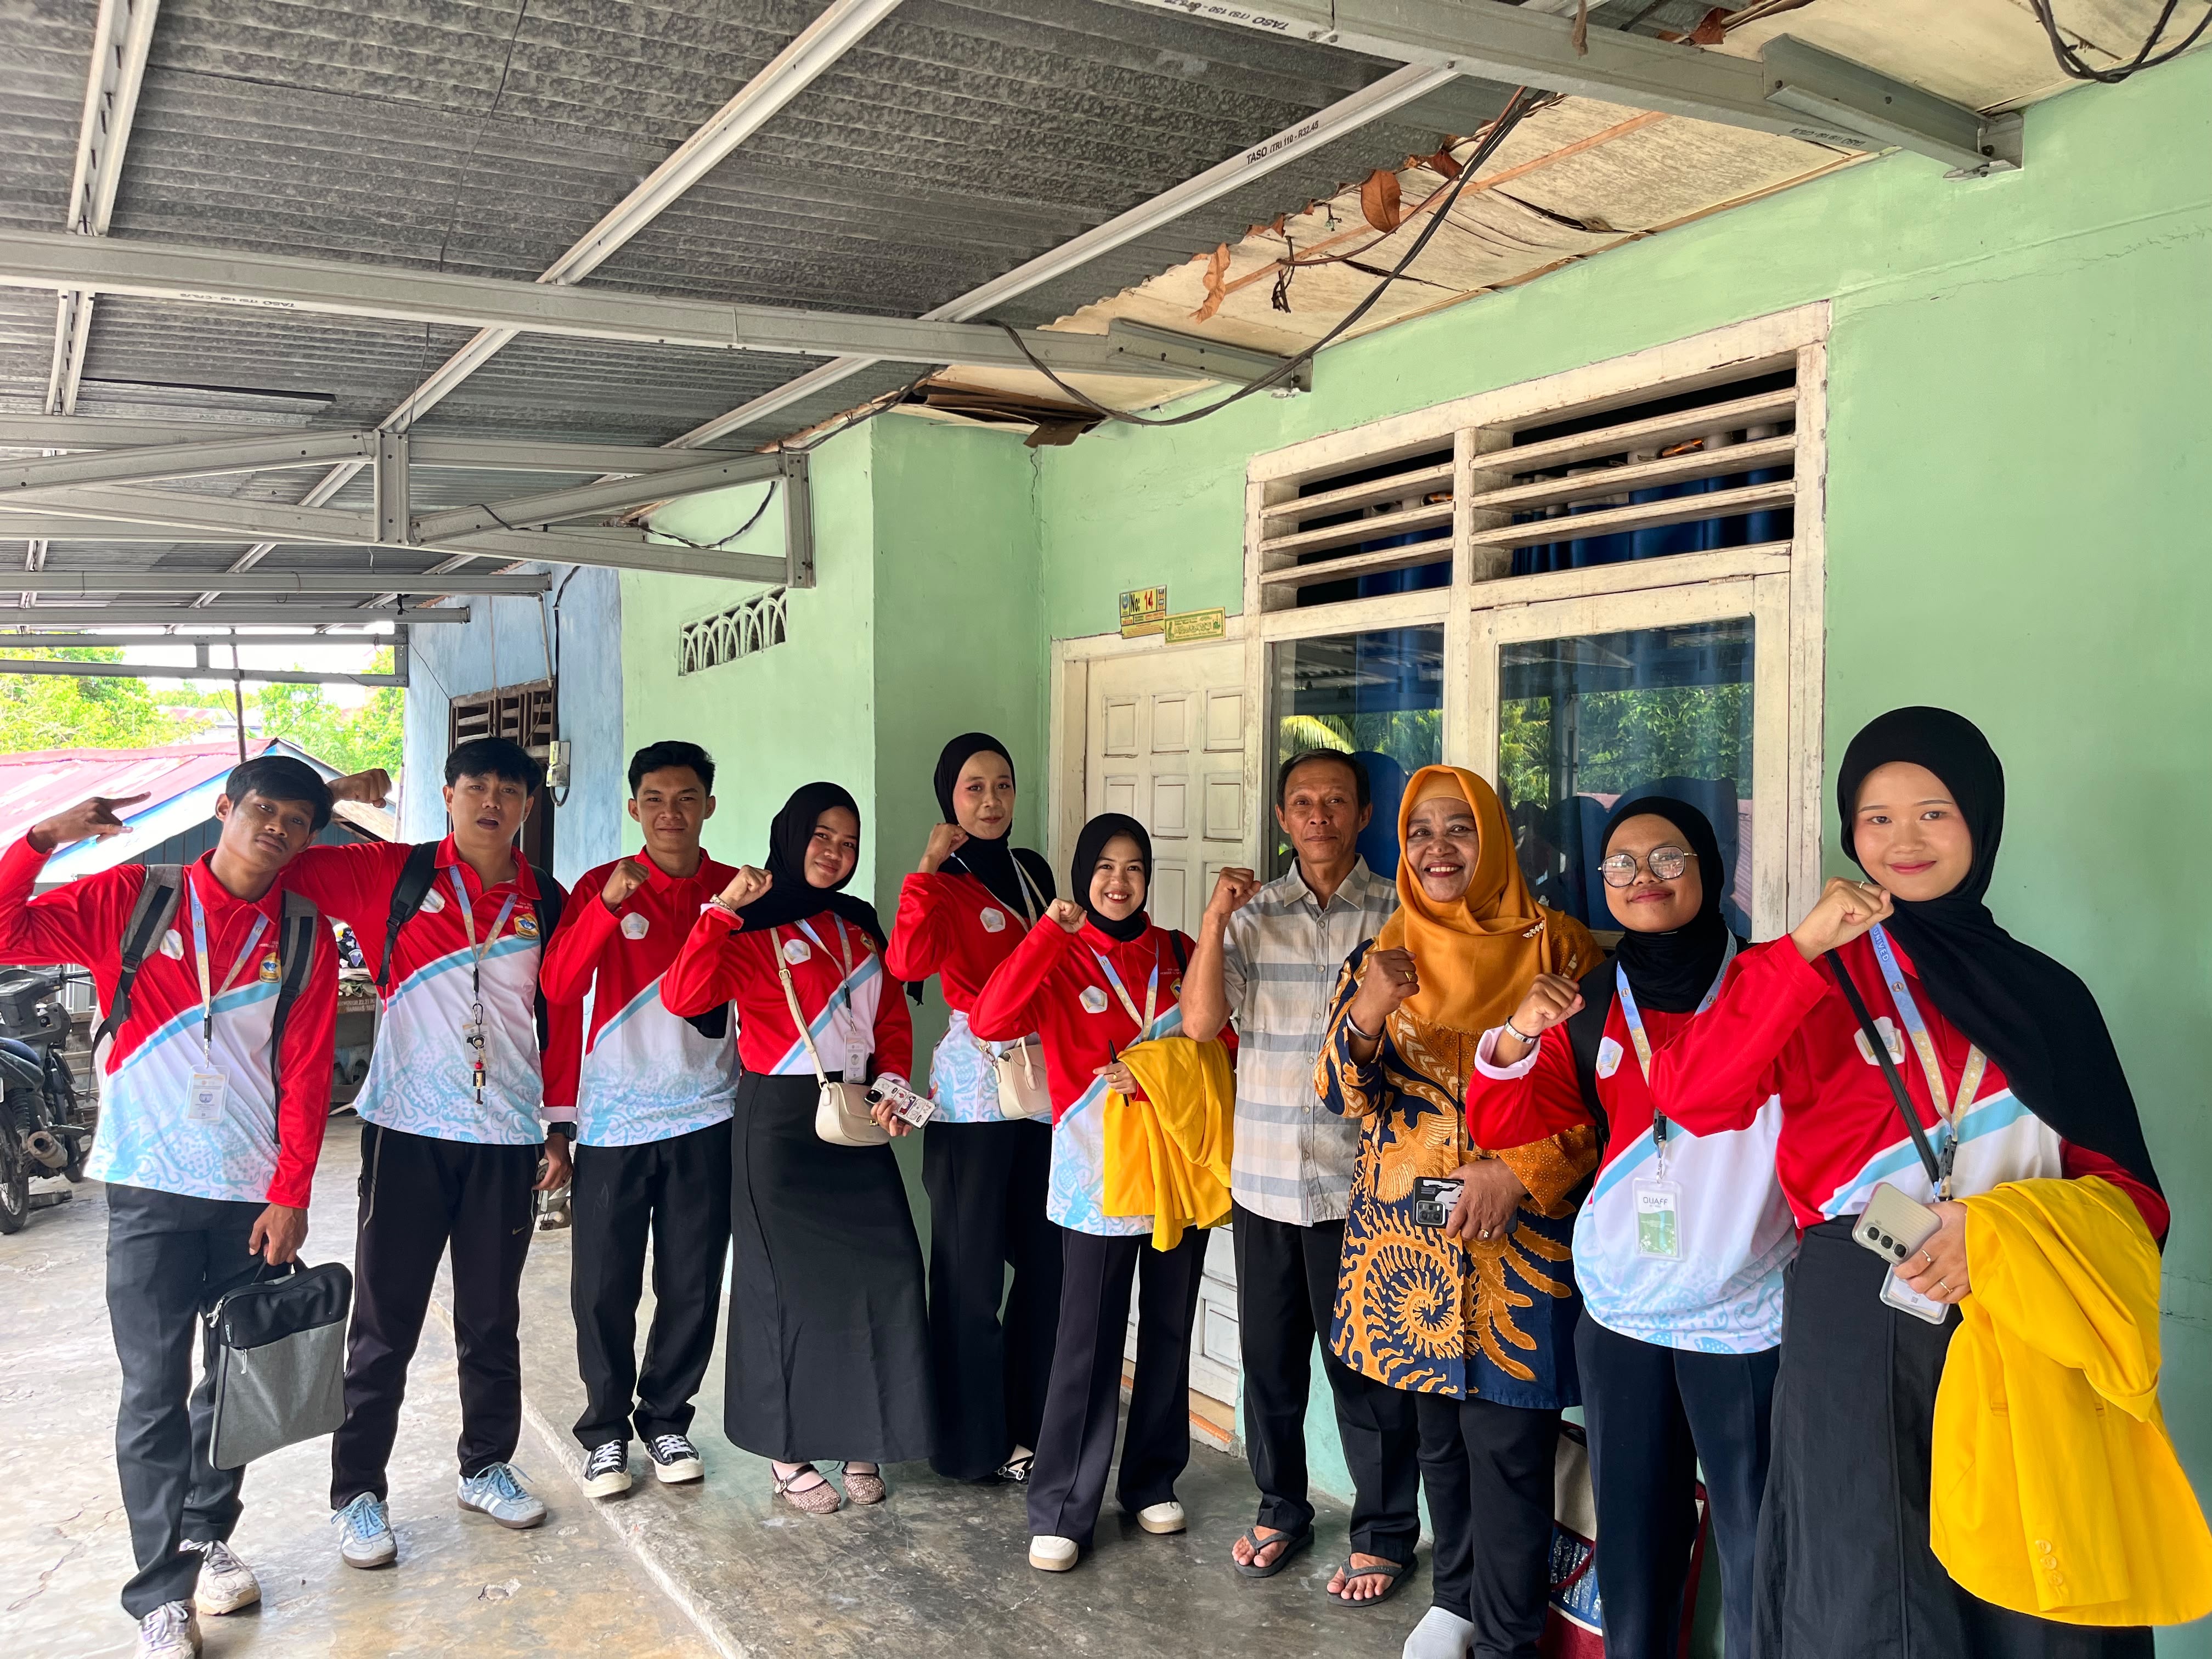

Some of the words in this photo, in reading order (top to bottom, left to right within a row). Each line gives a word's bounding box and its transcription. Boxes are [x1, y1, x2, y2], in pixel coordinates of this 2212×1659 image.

[1208, 6, 1227, 14] 150
[1252, 16, 1289, 30] TASO
[1246, 146, 1267, 165] TASO
[1284, 134, 1294, 146] 110
[1298, 120, 1319, 139] R32.45
[1144, 590, 1153, 611] 14
[1872, 927, 1889, 962] UNIVED
